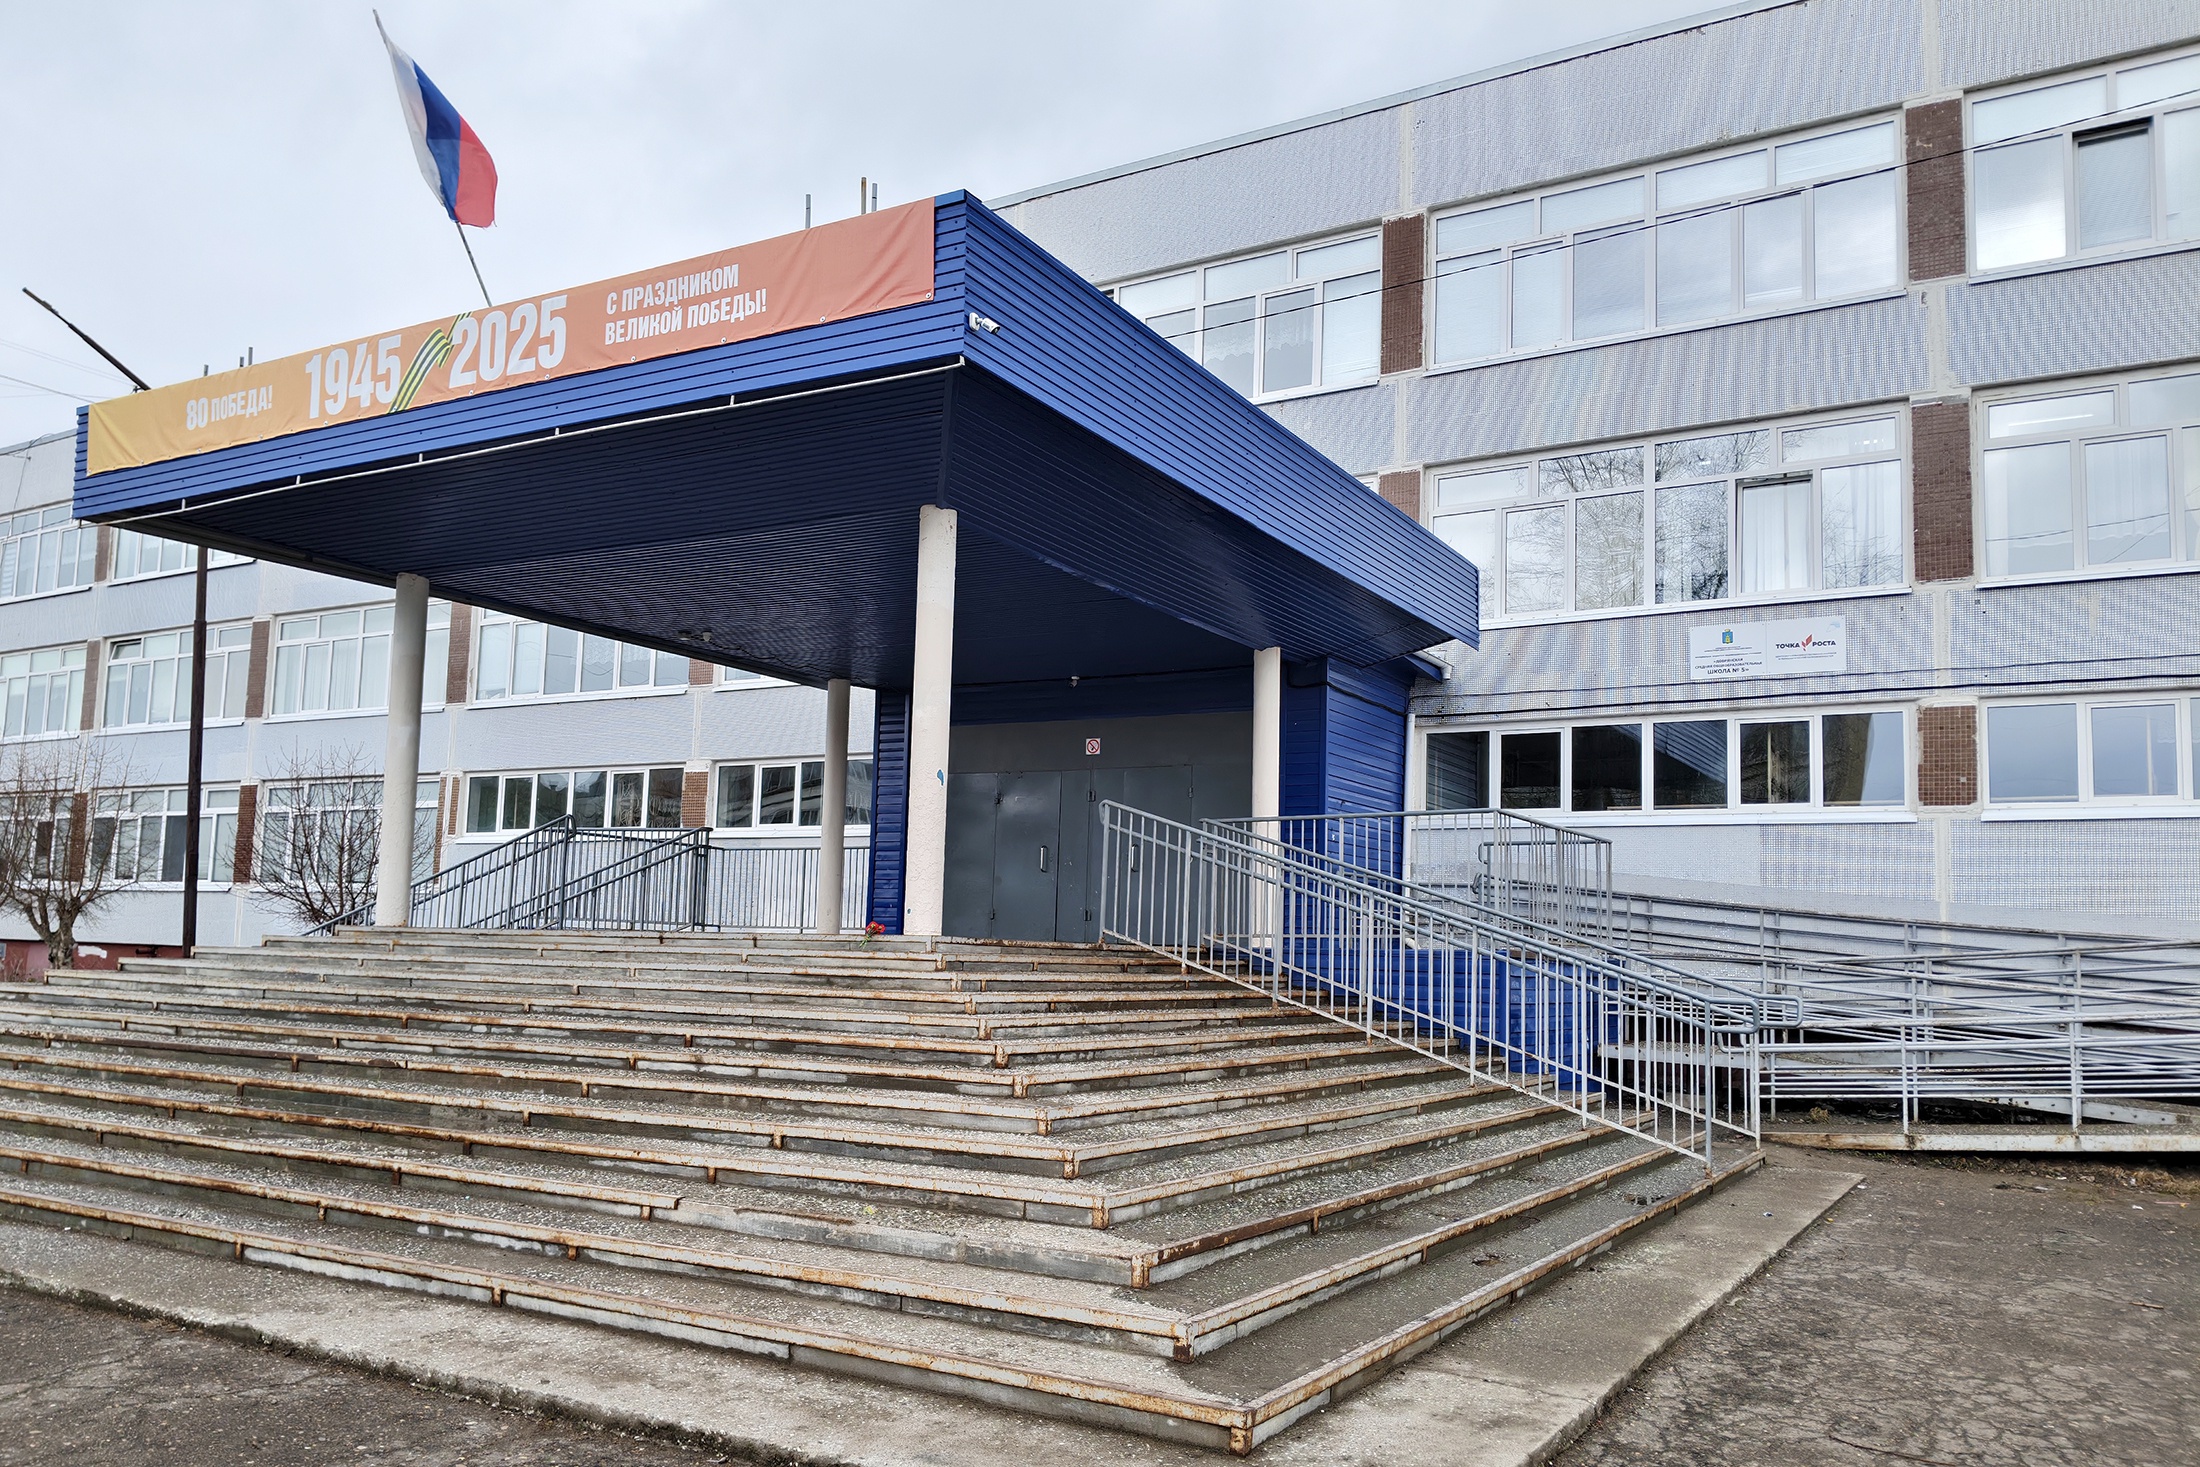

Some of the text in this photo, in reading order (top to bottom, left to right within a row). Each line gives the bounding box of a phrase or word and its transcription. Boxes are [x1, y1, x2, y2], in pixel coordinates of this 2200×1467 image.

[606, 263, 739, 315] С ПРАЗДНИКОМ
[604, 288, 767, 345] ВЕЛИКОЙ ПОБЕДЫ!
[305, 294, 568, 419] 1945 2025
[186, 384, 273, 431] 80 ПОБЕДА!
